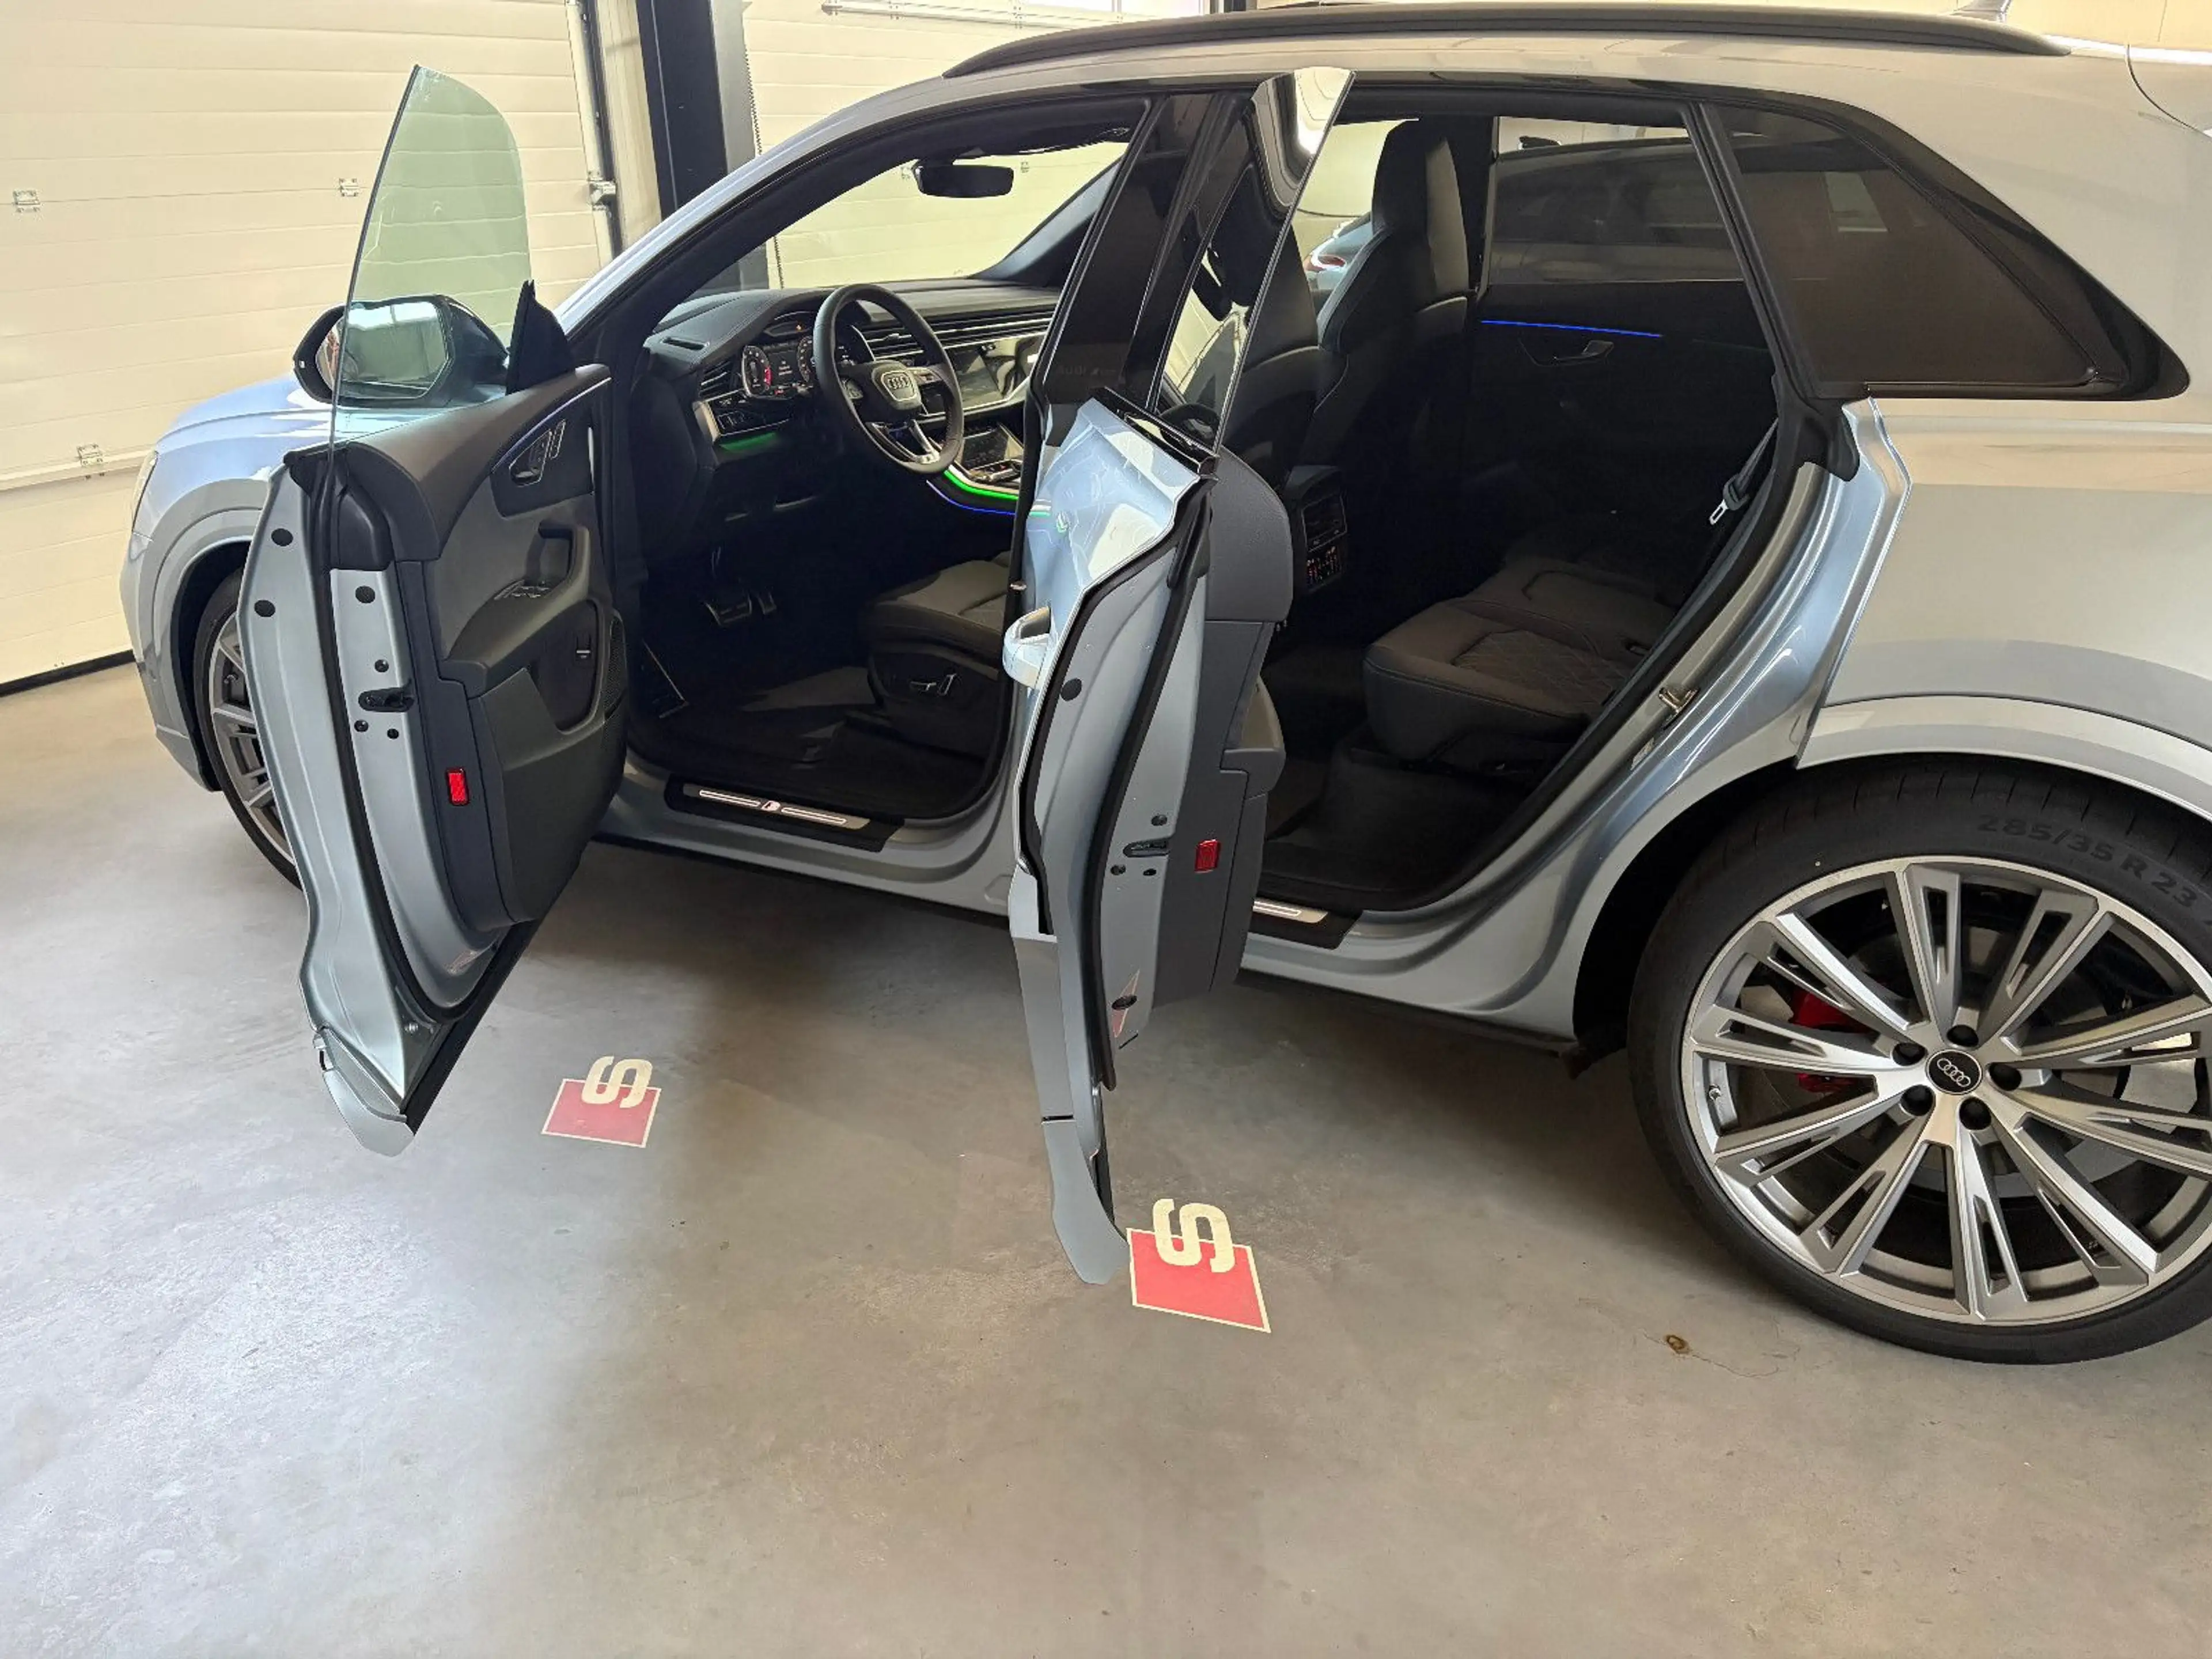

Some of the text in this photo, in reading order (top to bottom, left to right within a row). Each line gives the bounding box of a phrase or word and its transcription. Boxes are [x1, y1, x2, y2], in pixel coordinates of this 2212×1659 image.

[1977, 815, 2198, 907] 285/35 R 23
[582, 1056, 653, 1108] S
[1153, 1199, 1235, 1272] S
